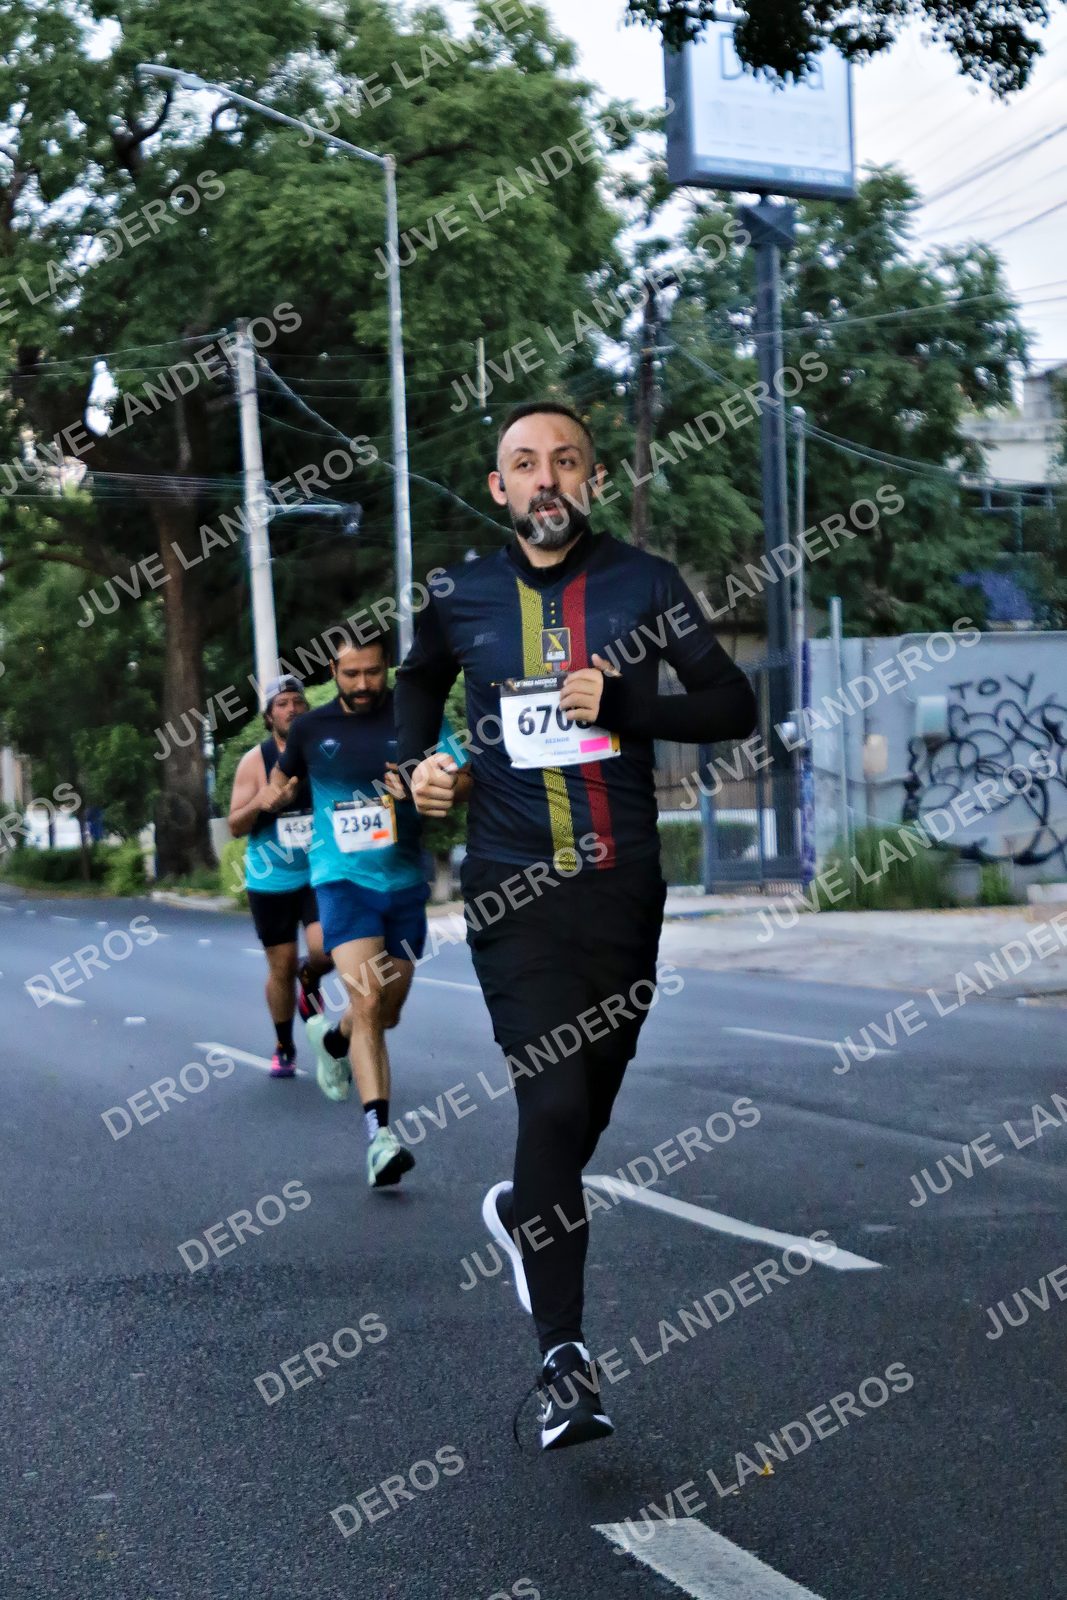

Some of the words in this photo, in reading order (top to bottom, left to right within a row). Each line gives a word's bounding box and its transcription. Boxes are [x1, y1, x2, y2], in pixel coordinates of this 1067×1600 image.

[949, 672, 1035, 704] TOY
[518, 704, 592, 735] 670
[340, 813, 382, 833] 2394
